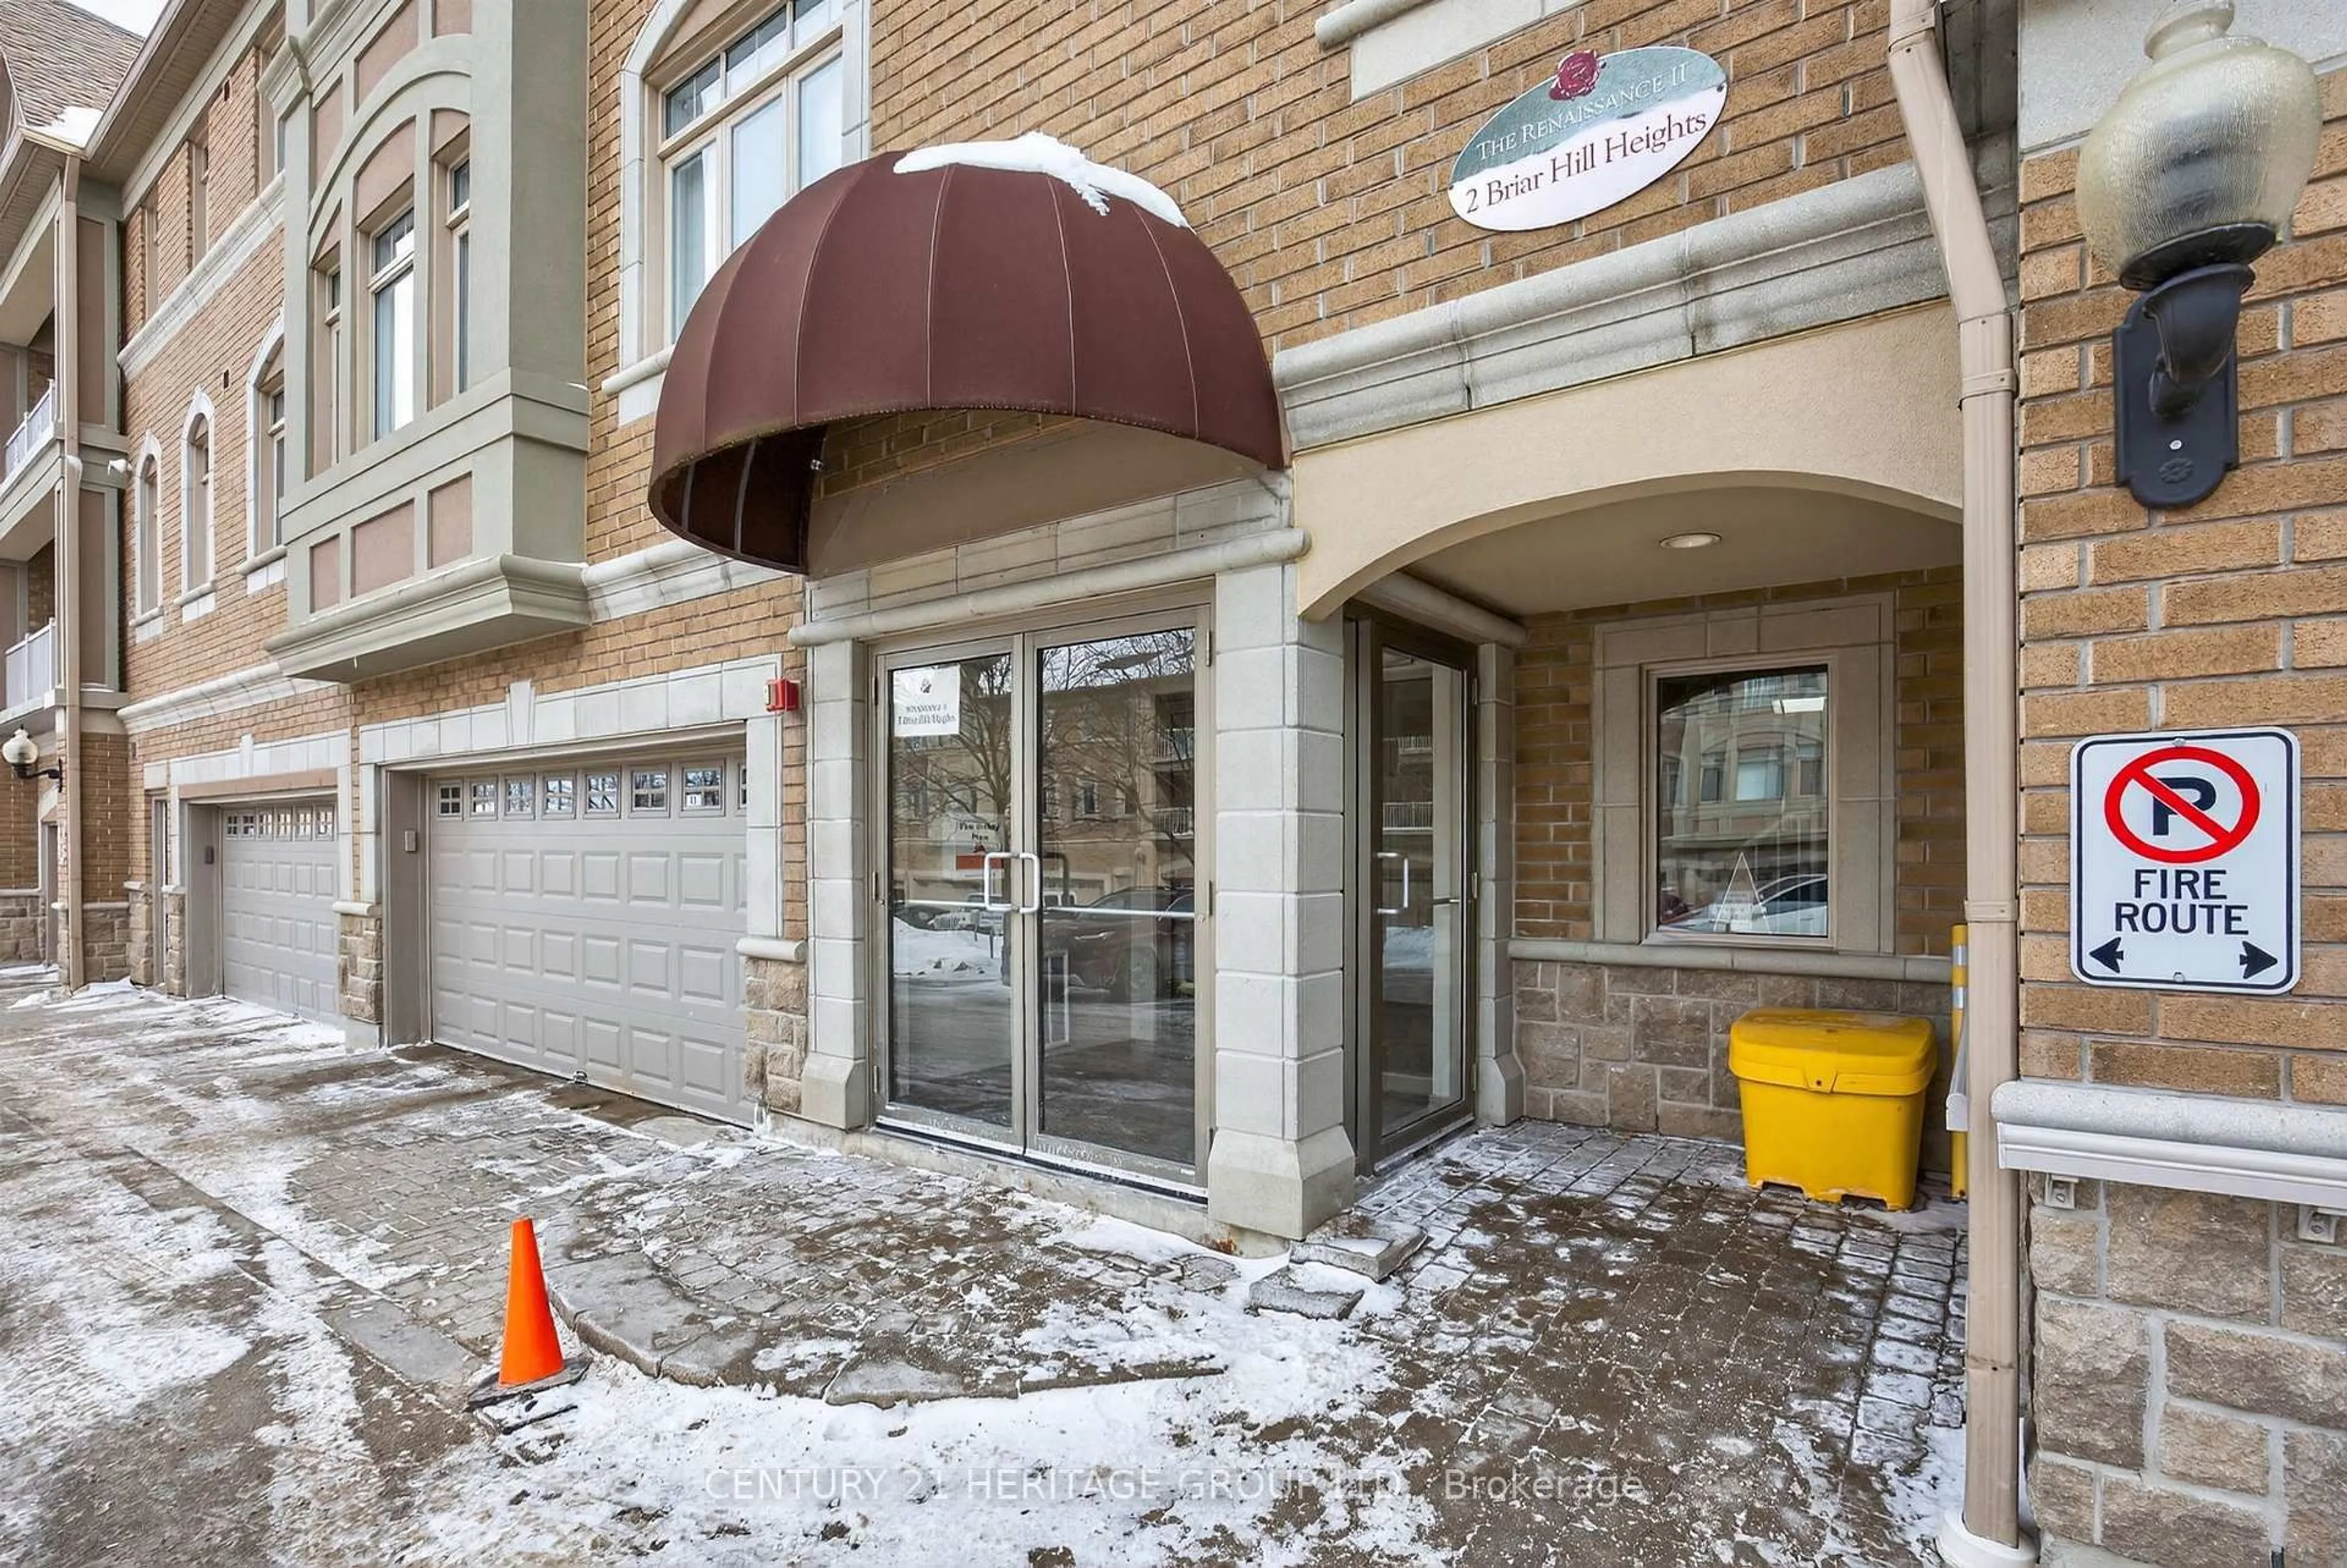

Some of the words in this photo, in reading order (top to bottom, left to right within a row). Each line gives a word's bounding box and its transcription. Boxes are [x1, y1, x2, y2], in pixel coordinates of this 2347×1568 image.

[1477, 130, 1516, 161] THE
[1522, 76, 1664, 143] RENAISSANCE
[1672, 62, 1691, 86] II
[1466, 188, 1478, 214] 2
[1487, 172, 1544, 207] Briar
[1551, 143, 1596, 184] Hill
[1604, 112, 1707, 163] Heights
[2134, 868, 2228, 900] FIRE
[2114, 902, 2249, 936] ROUTE
